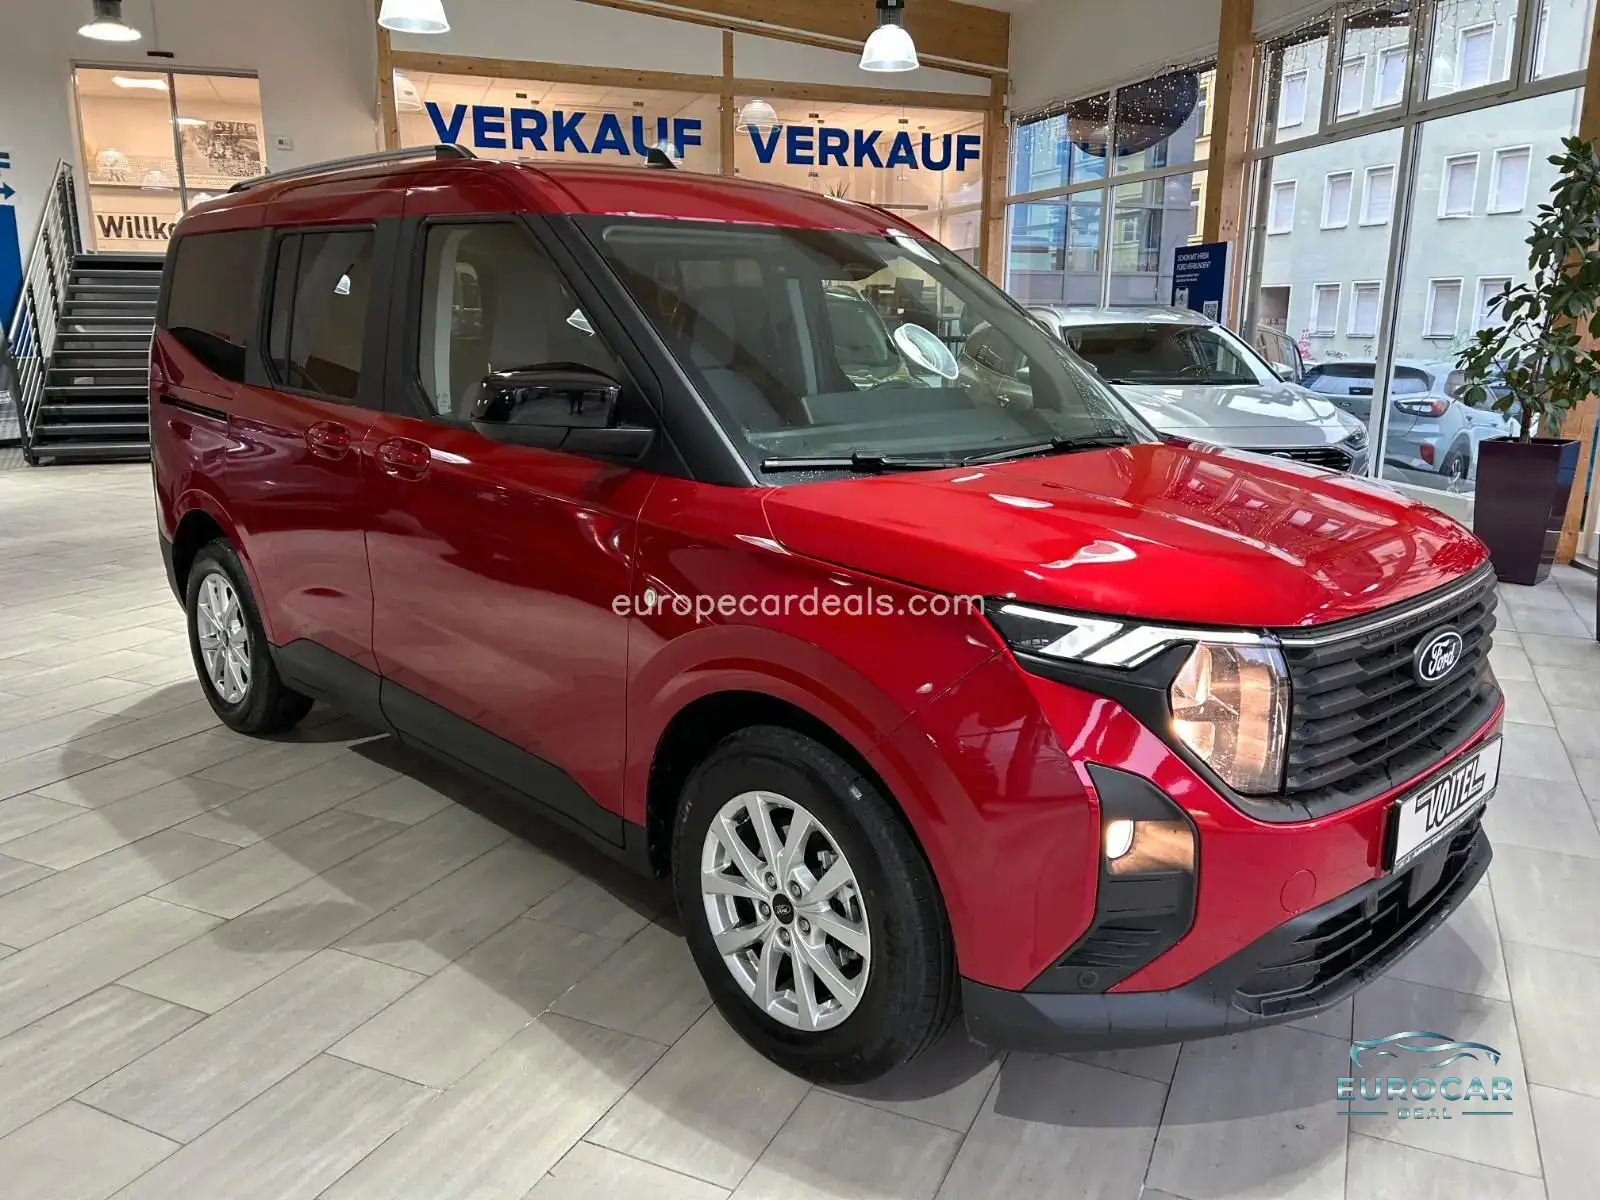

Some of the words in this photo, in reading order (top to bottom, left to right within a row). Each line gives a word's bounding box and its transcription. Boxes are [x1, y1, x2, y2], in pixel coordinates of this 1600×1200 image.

[425, 102, 701, 159] VERKAUF
[748, 124, 980, 171] VERKAUF
[1428, 639, 1456, 675] Ford
[1415, 754, 1486, 832] VOITEL
